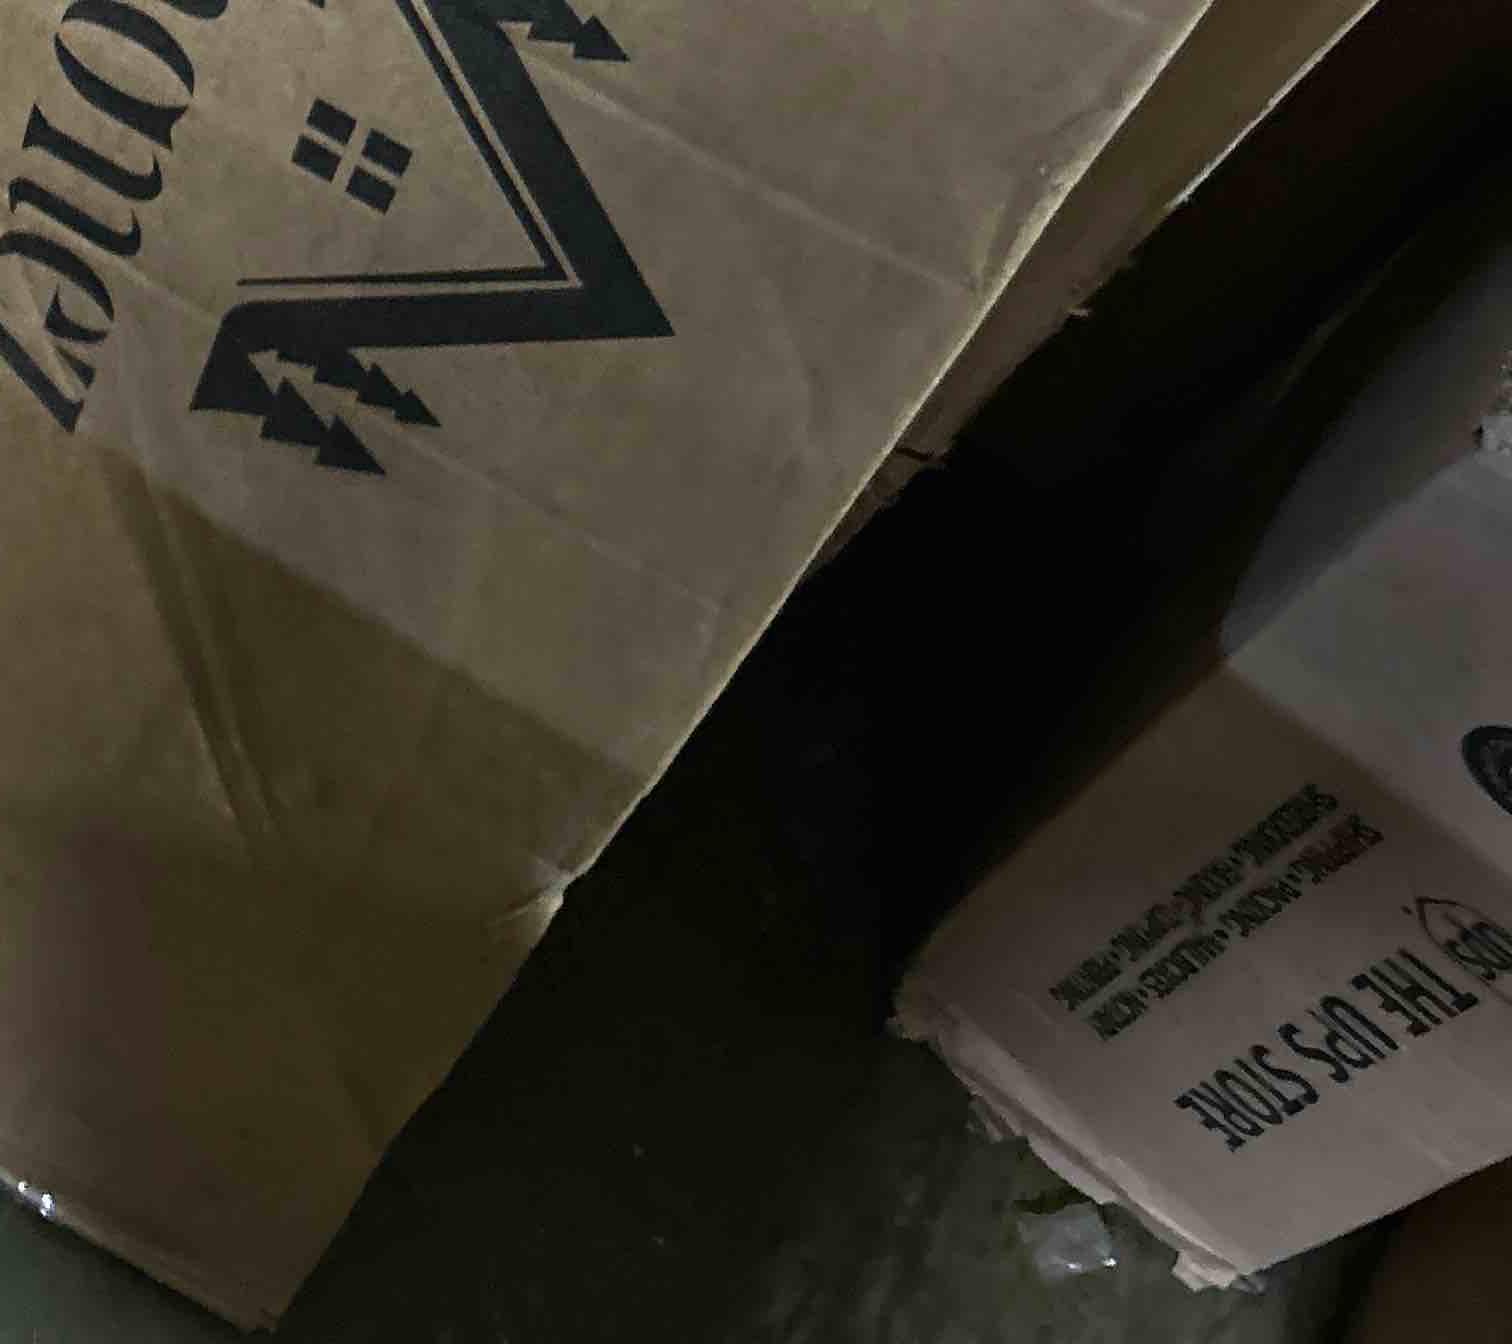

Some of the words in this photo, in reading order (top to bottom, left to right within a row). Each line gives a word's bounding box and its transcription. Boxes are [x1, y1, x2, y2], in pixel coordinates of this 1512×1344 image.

[1352, 950, 1478, 1038] THE
[1278, 996, 1399, 1083] UPS
[1174, 1045, 1320, 1152] STORE
